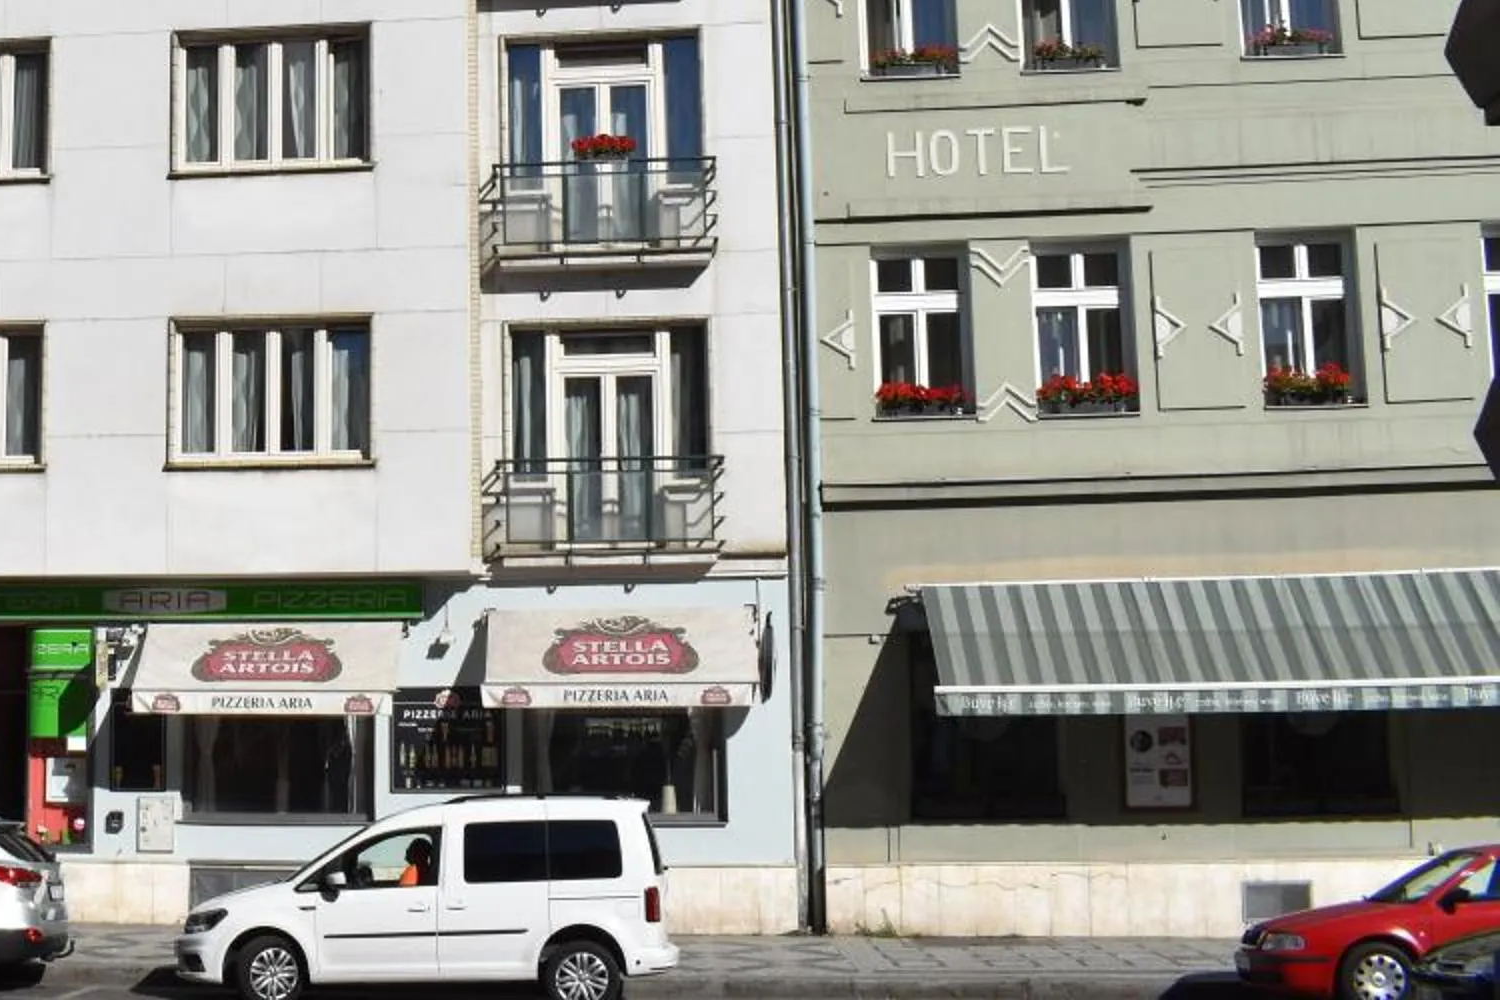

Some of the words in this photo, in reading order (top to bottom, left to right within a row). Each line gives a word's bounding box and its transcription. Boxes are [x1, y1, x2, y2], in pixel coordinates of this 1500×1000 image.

[885, 124, 1070, 178] HOTEL
[118, 590, 212, 610] ARIA
[252, 589, 408, 610] PIZZERIA
[571, 640, 670, 653] STELLA
[222, 649, 315, 662] STELLA
[571, 652, 671, 666] ARTOIS
[219, 662, 316, 675] ARTOIS
[211, 696, 274, 709] PIZZERIA
[278, 696, 313, 709] ARIA
[563, 689, 629, 703] PIZZERIA
[633, 689, 669, 702] ARIA
